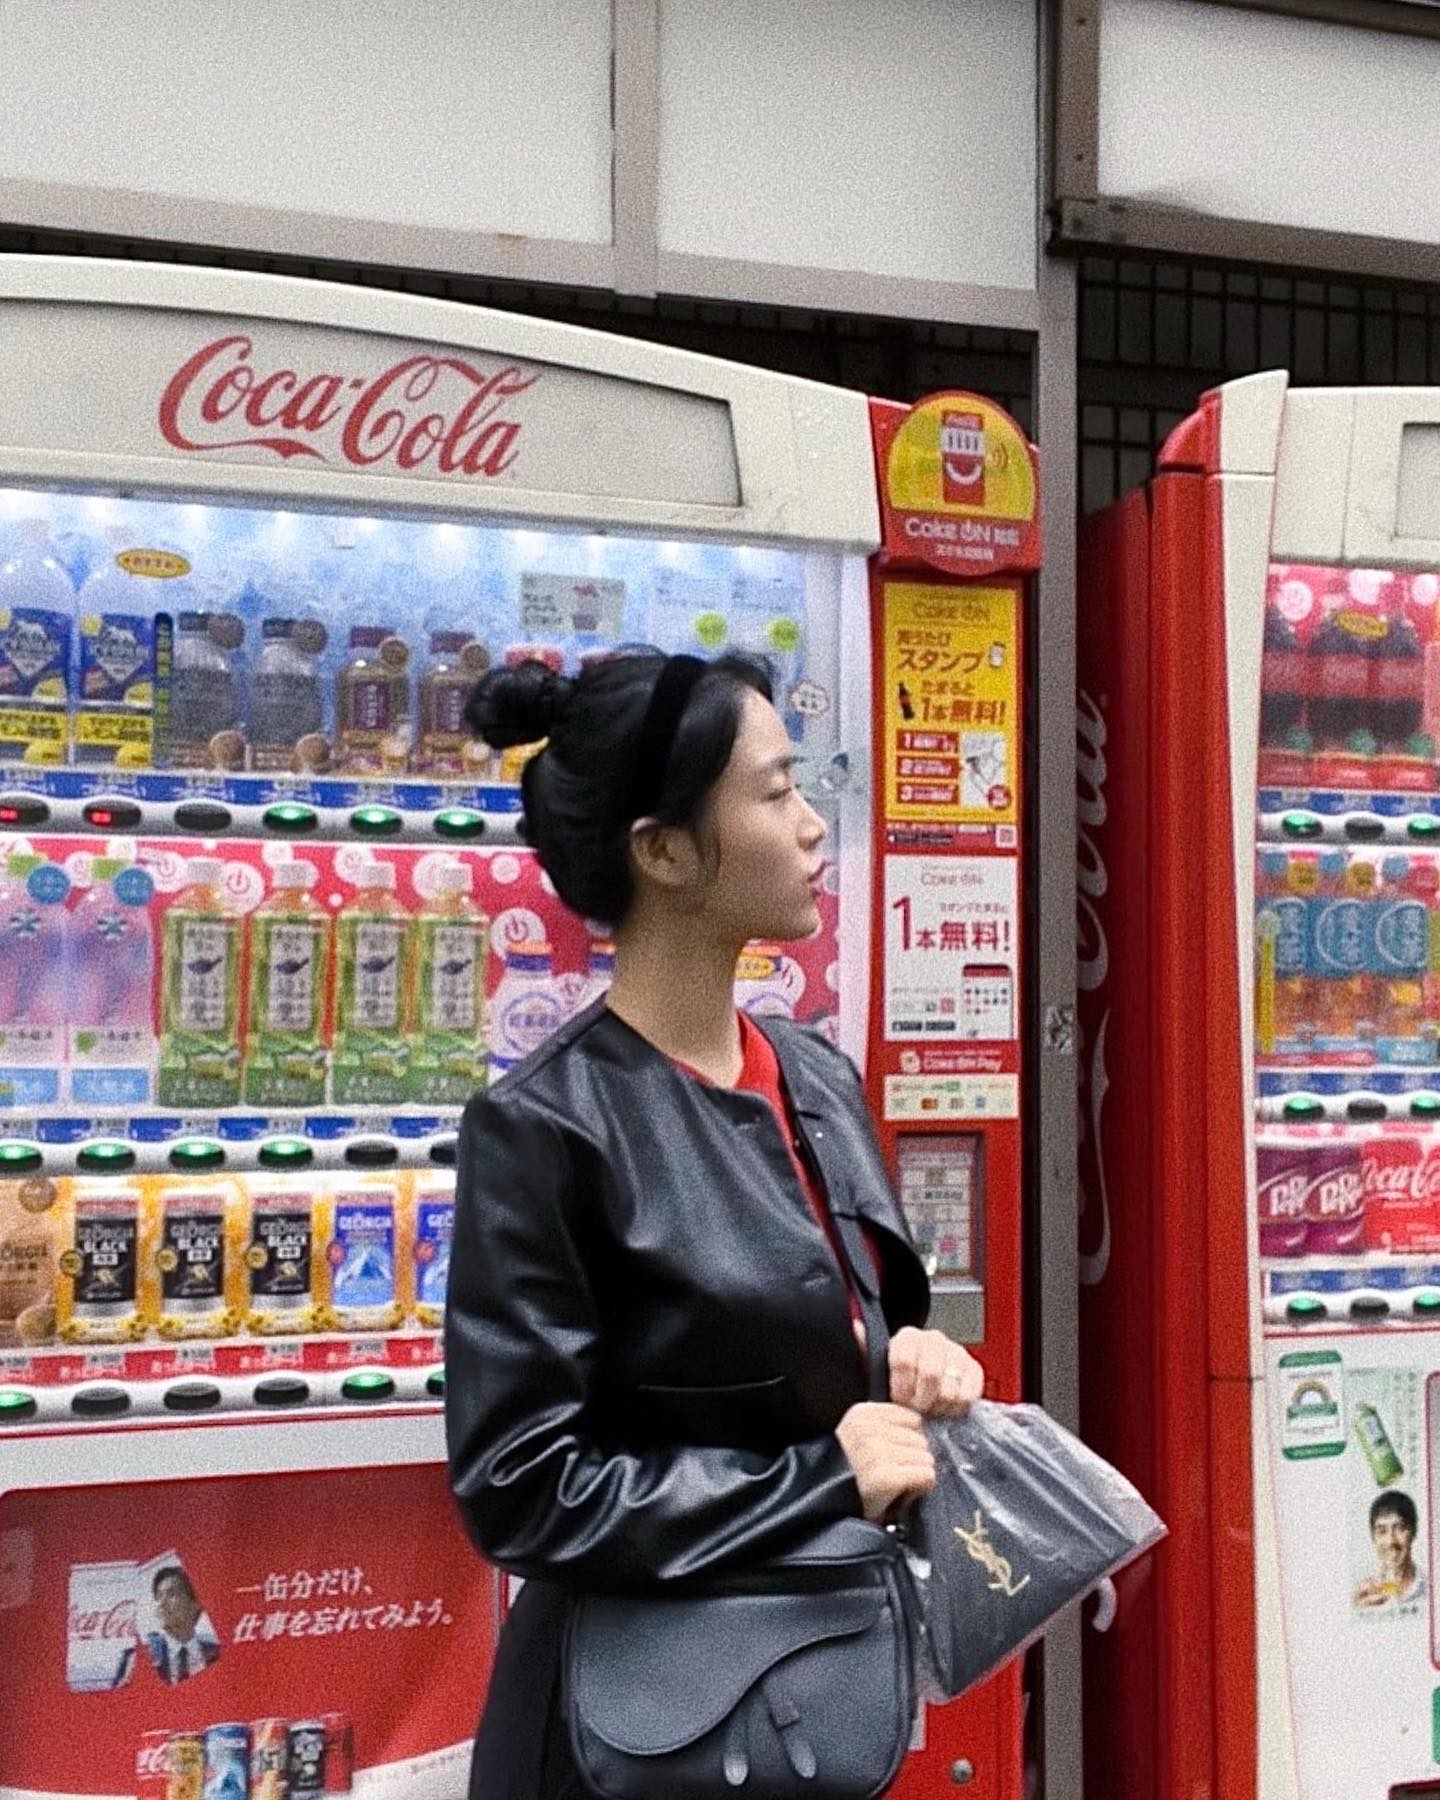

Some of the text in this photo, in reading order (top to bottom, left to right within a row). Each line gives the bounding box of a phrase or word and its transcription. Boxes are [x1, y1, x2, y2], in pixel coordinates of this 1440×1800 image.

[158, 335, 540, 478] Coca-Cola
[339, 1213, 392, 1229] GEORGIA
[83, 1240, 128, 1254] BLACK
[176, 1236, 220, 1250] BLACK
[268, 1234, 308, 1247] BLACK
[953, 1509, 1031, 1597] YSL
[235, 1566, 375, 1602] 一缶分だけ、
[232, 1597, 455, 1643] 仕事を忘れてみよう。
